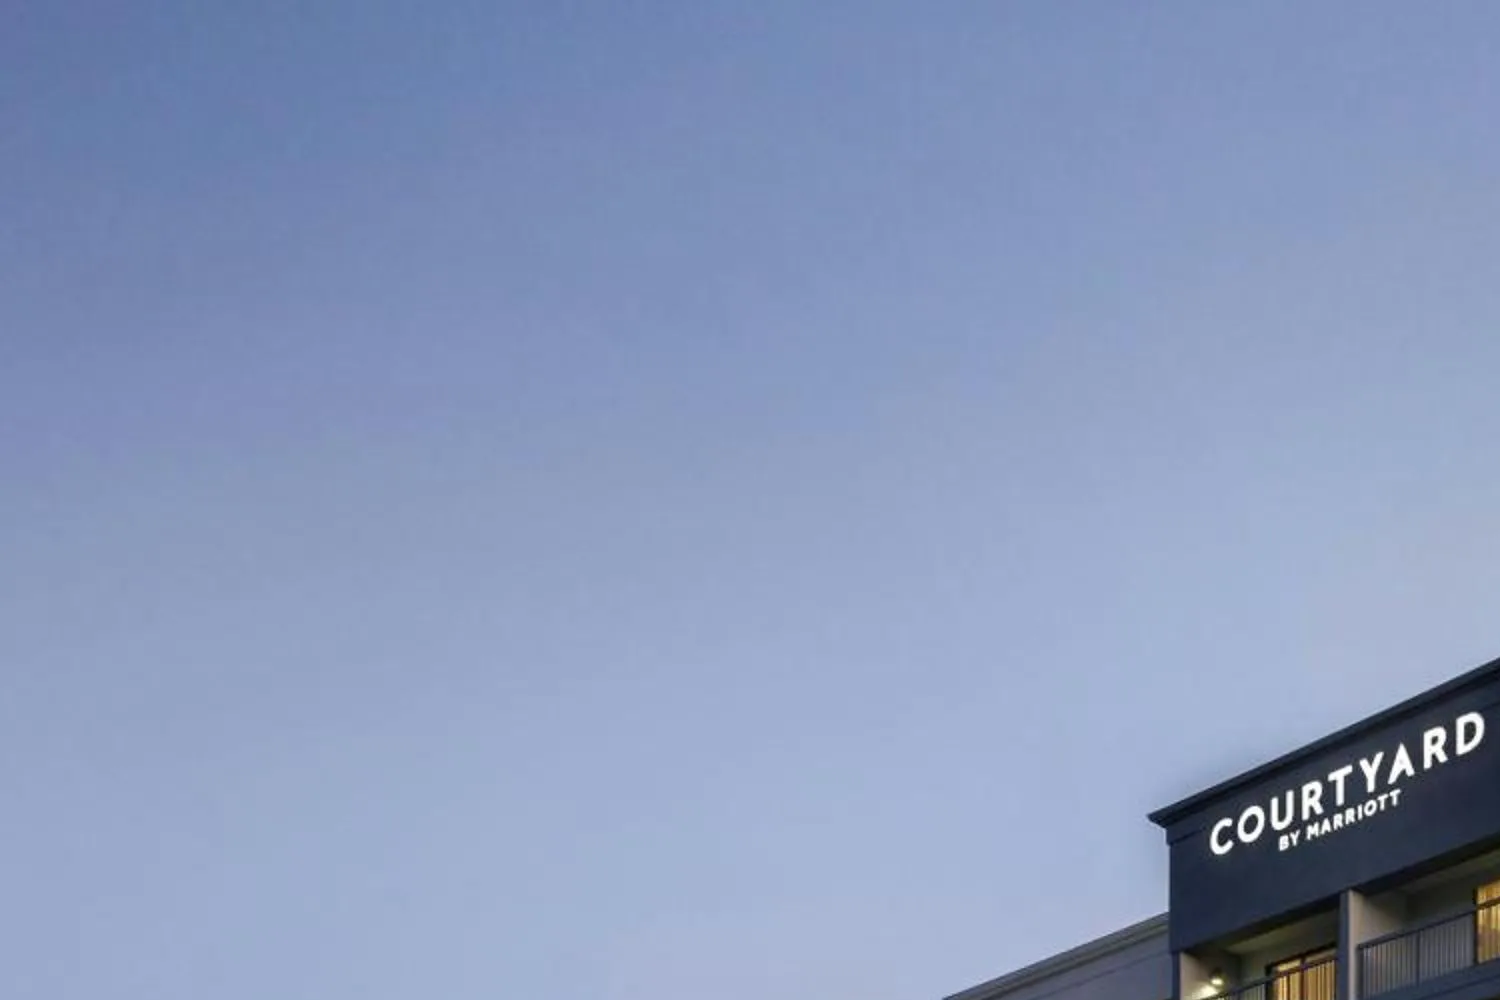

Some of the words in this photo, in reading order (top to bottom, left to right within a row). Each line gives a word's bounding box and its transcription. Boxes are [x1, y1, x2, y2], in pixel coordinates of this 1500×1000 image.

[1209, 711, 1486, 855] COURTYARD
[1278, 829, 1301, 851] BY
[1305, 788, 1402, 841] MARRIOTT
